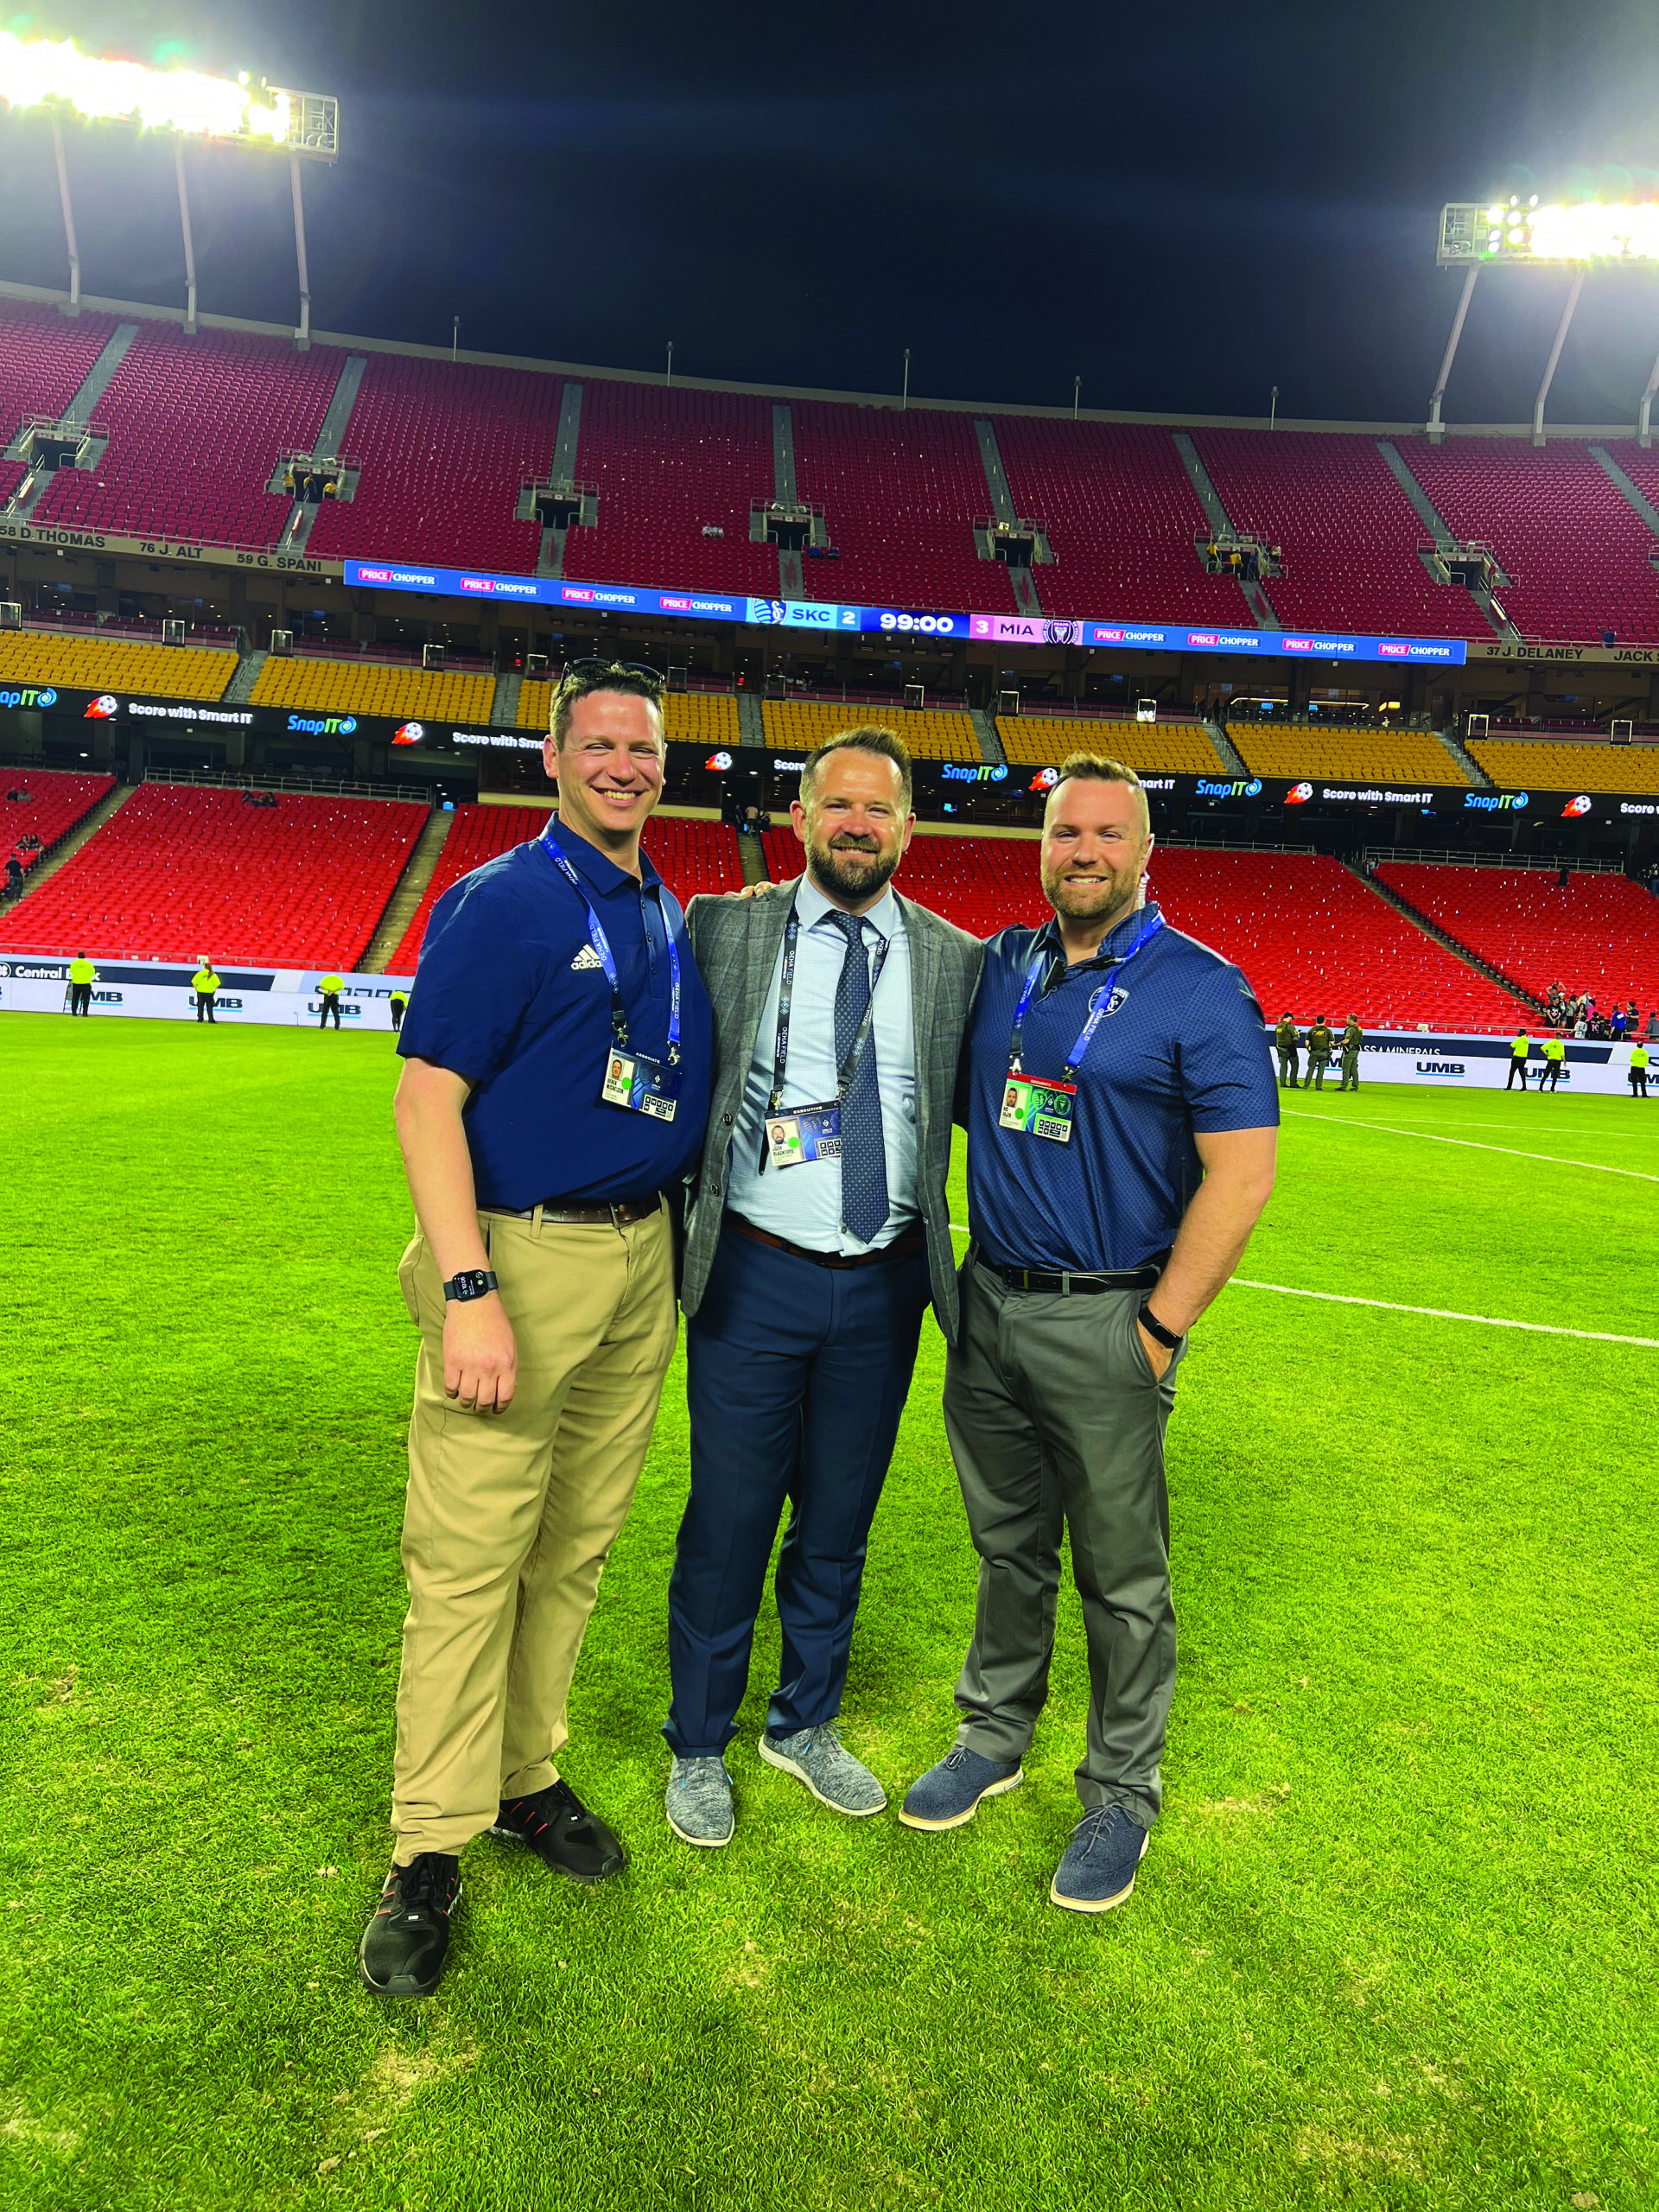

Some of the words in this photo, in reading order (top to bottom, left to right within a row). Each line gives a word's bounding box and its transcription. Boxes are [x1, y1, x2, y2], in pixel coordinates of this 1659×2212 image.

[0, 525, 16, 537] 58
[36, 529, 105, 548] THOMAS
[139, 542, 155, 553] 76
[176, 545, 204, 559] ALT
[237, 554, 253, 564] 59
[257, 556, 273, 568] G.
[276, 557, 321, 572] SPANI
[361, 570, 388, 581] PRICE
[392, 573, 435, 585] CHOPPER
[463, 580, 492, 590] PRICE
[495, 582, 537, 594] CHOPPER
[564, 590, 591, 600] PRICE
[594, 593, 636, 604] CHOPPER
[663, 599, 688, 608] PRICE
[692, 601, 733, 613] CHOPPER
[792, 608, 830, 622] SKC
[842, 611, 855, 625] 2
[880, 613, 954, 633] 99:00
[976, 620, 989, 633] 3
[1000, 623, 1034, 636] MIA
[1096, 630, 1122, 639] PRICE
[1125, 632, 1165, 642] CHOPPER
[1191, 635, 1216, 644] PRICE
[1219, 637, 1259, 646] CHOPPER
[1285, 640, 1310, 649] PRICE
[1314, 642, 1355, 652] CHOPPER
[1381, 645, 1406, 654] PRICE
[1410, 646, 1450, 656] CHOPPER
[1486, 646, 1498, 656] 37
[1516, 647, 1584, 660] DELANEY
[1613, 651, 1653, 662] JACK
[0, 690, 41, 708] apIT
[129, 702, 167, 715] Score
[168, 707, 197, 720] with
[198, 709, 239, 723] Smart
[240, 713, 253, 724] IT
[287, 715, 343, 735] SnapIT
[452, 732, 490, 746] Score
[490, 734, 518, 747] with
[518, 737, 544, 749] Sma
[773, 759, 806, 772] Score
[942, 764, 994, 784] SnapIT
[1138, 779, 1164, 790] mart
[1164, 779, 1176, 790] IT
[1196, 779, 1248, 799] SnapIT
[1323, 788, 1357, 800] Score
[1357, 789, 1383, 802] with
[1384, 791, 1421, 804] Smart
[1421, 793, 1433, 804] IT
[1464, 793, 1515, 812] SnapIT
[1620, 802, 1654, 814] Score
[589, 924, 600, 943] FIELD
[596, 943, 607, 962] GEHA
[570, 958, 603, 970] adida
[16, 966, 62, 979] Central
[66, 967, 100, 981] Bk
[308, 1002, 361, 1014] UB
[1416, 1061, 1465, 1074] UMB
